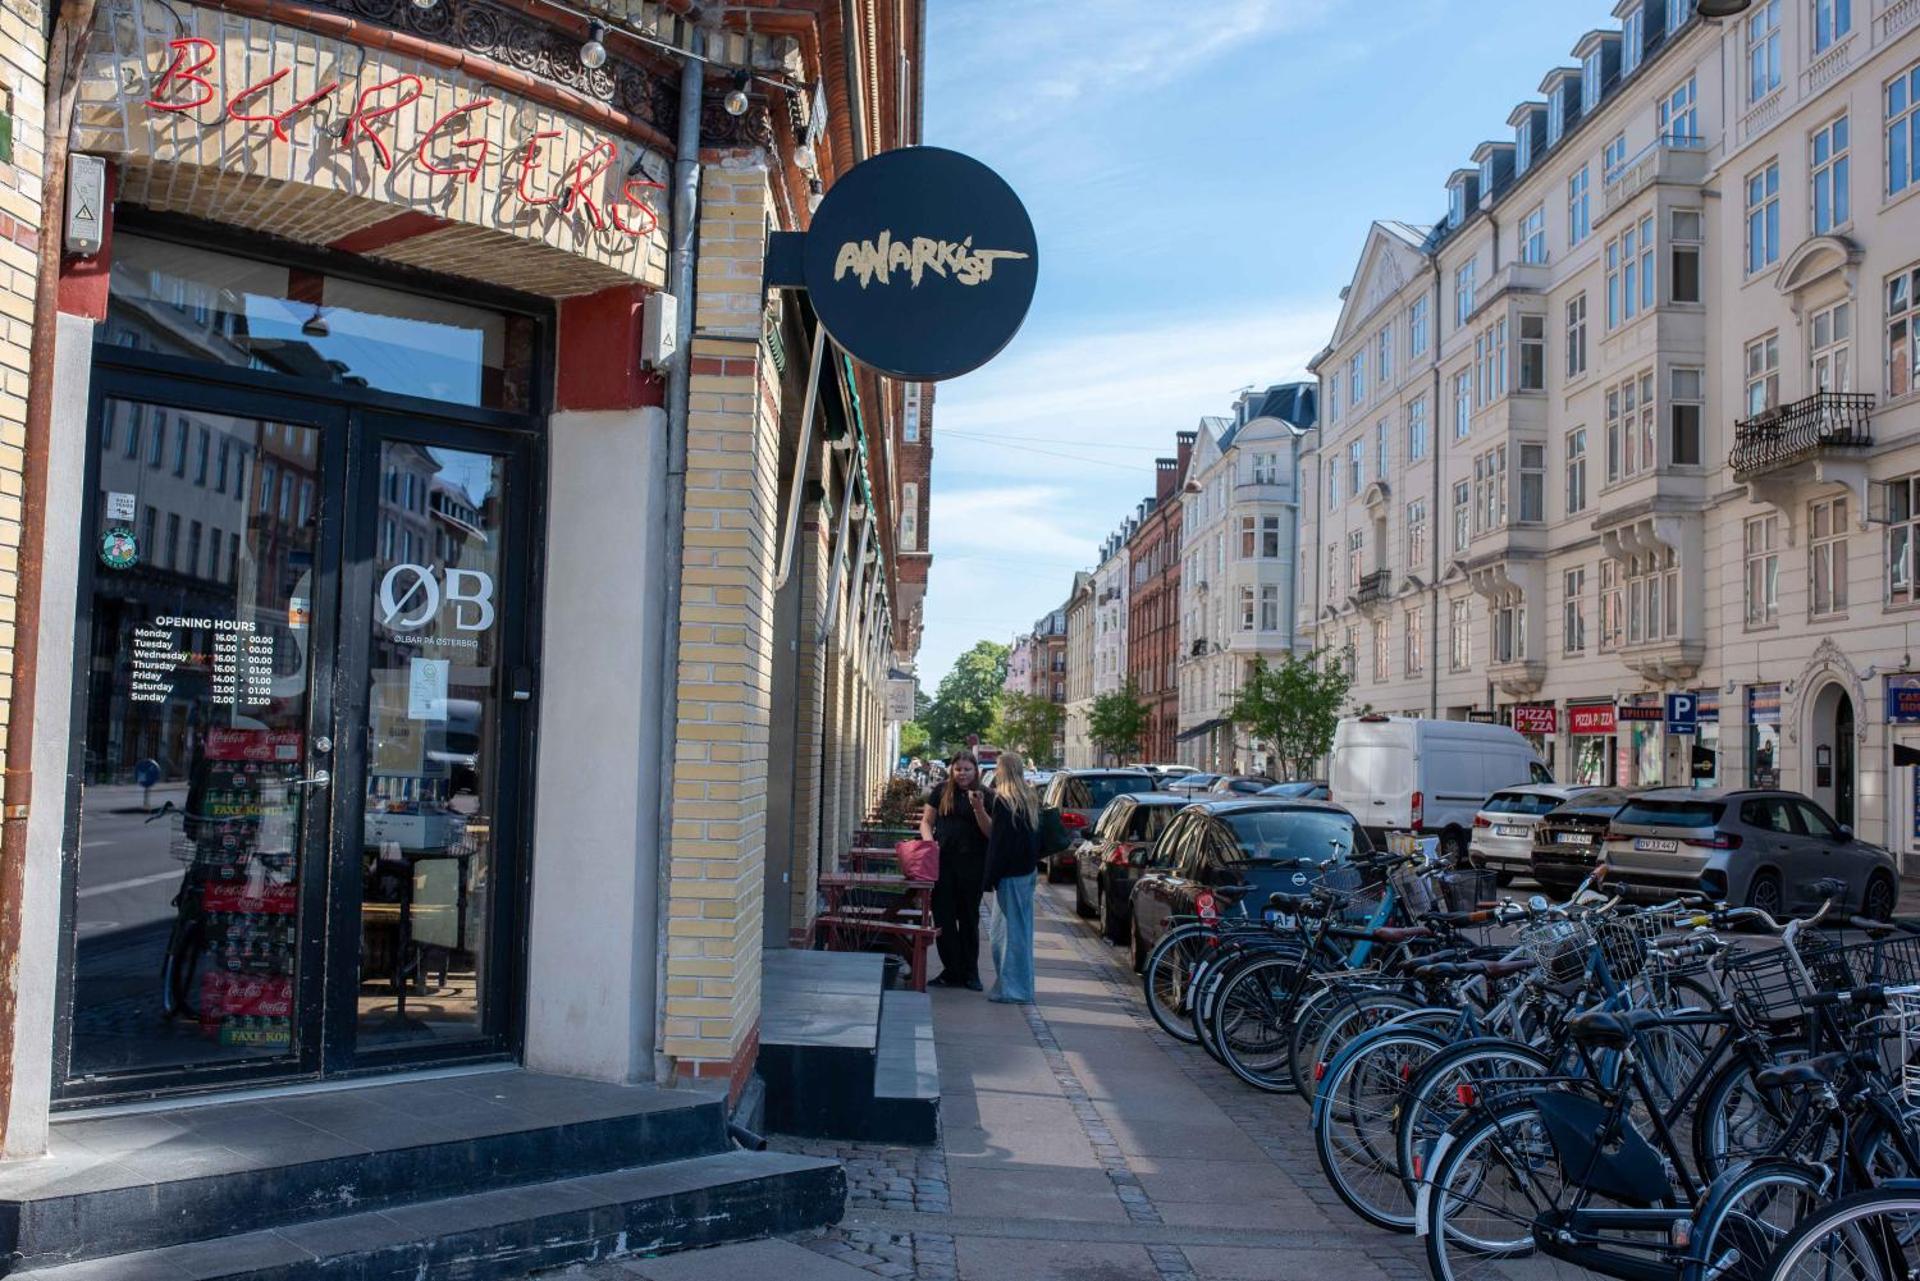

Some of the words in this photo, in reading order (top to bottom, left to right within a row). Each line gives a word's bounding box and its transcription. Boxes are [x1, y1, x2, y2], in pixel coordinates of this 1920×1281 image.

[145, 37, 666, 237] BURGERS
[380, 563, 495, 631] ØB
[155, 616, 212, 629] OPENING
[214, 620, 256, 632] HOURS
[135, 629, 172, 640] Monday
[215, 633, 238, 642] 16.00
[249, 636, 274, 644] 00.00
[394, 635, 422, 644] ØLBAR
[424, 636, 434, 645] PÅ
[436, 638, 479, 648] ØSTERBRO
[134, 639, 173, 650] Tuesday
[215, 644, 237, 652] 16.00
[249, 646, 273, 654] 00.00
[134, 650, 188, 662] Wednesday
[214, 654, 237, 662] 16.00
[248, 656, 273, 664] 00.00
[133, 660, 176, 671] Thursday
[214, 665, 236, 673] 16.00
[249, 666, 272, 674] 01.00
[133, 671, 162, 681] Friday
[212, 675, 236, 683] 14.00
[249, 677, 272, 685] 01.00
[132, 682, 173, 692] Saturday
[213, 685, 235, 693] 12.00
[248, 687, 271, 695] 01.00
[131, 692, 166, 703] Sunday
[212, 696, 235, 704] 12.00
[247, 697, 271, 705] 23.00
[1516, 709, 1553, 720] PIZZA
[1675, 697, 1691, 720] P
[1575, 713, 1593, 727] PIZZA
[231, 1030, 261, 1042] FAXE
